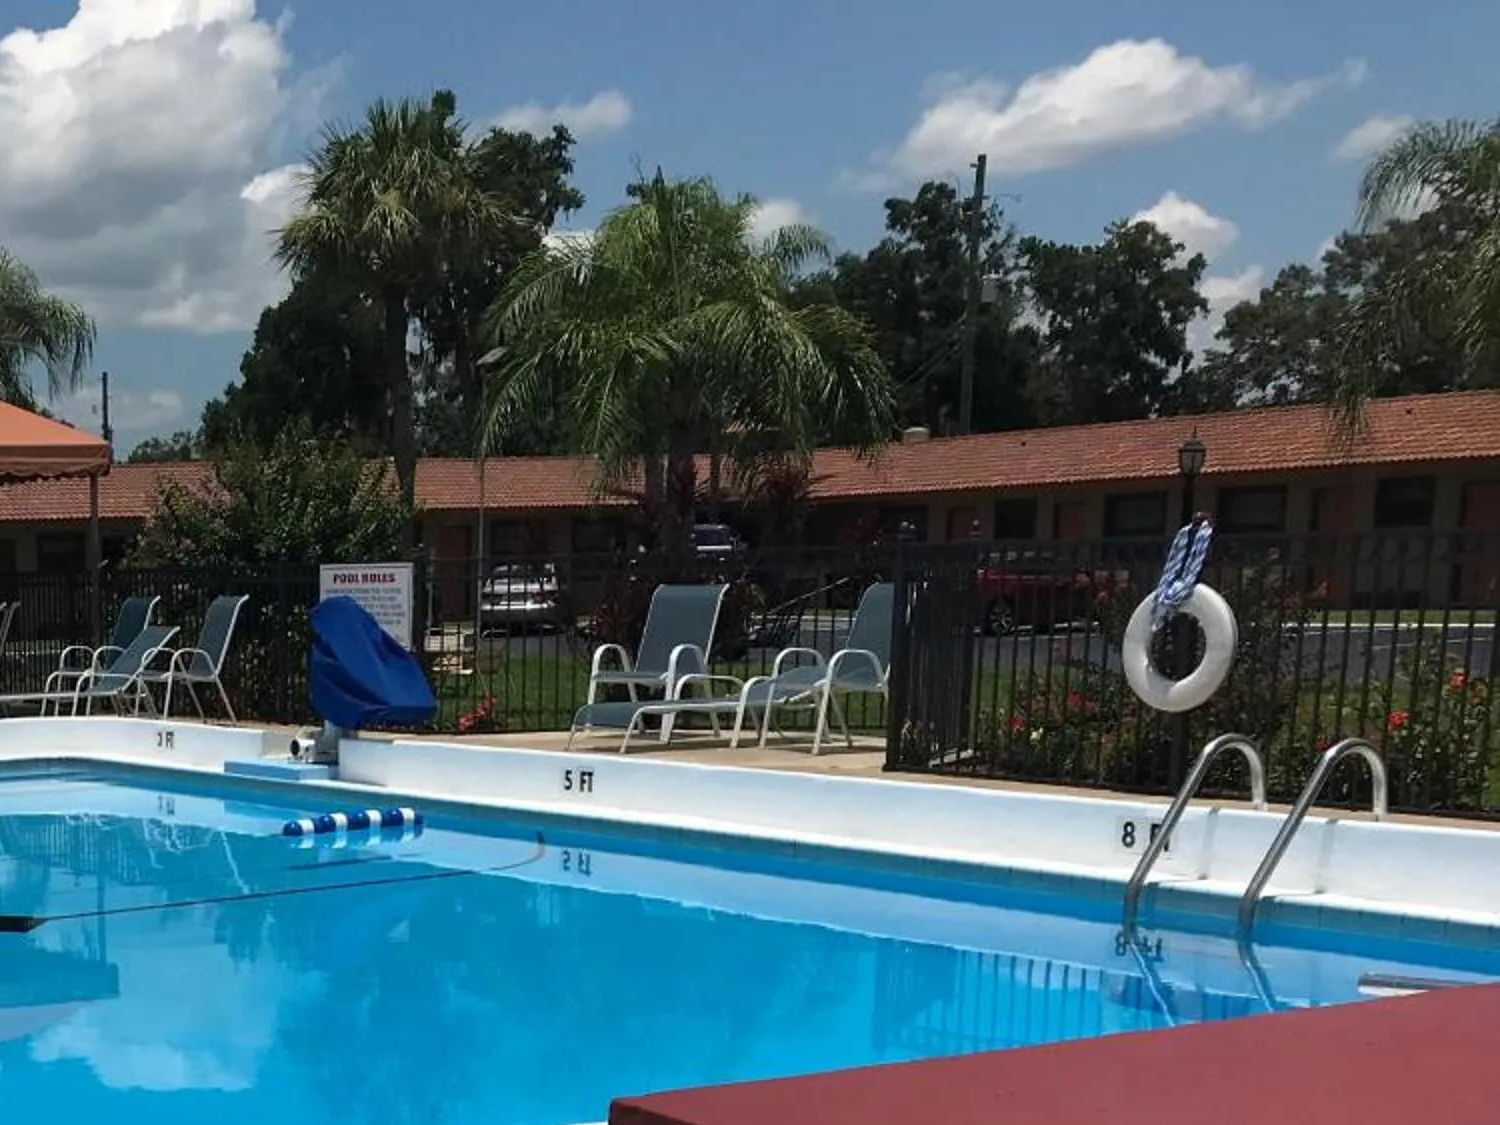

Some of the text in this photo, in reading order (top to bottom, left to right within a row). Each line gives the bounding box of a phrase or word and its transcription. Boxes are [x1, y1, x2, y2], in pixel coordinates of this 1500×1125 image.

[333, 573, 396, 584] POOL RULES
[564, 769, 594, 793] 5 FT
[1122, 821, 1135, 848] 8
